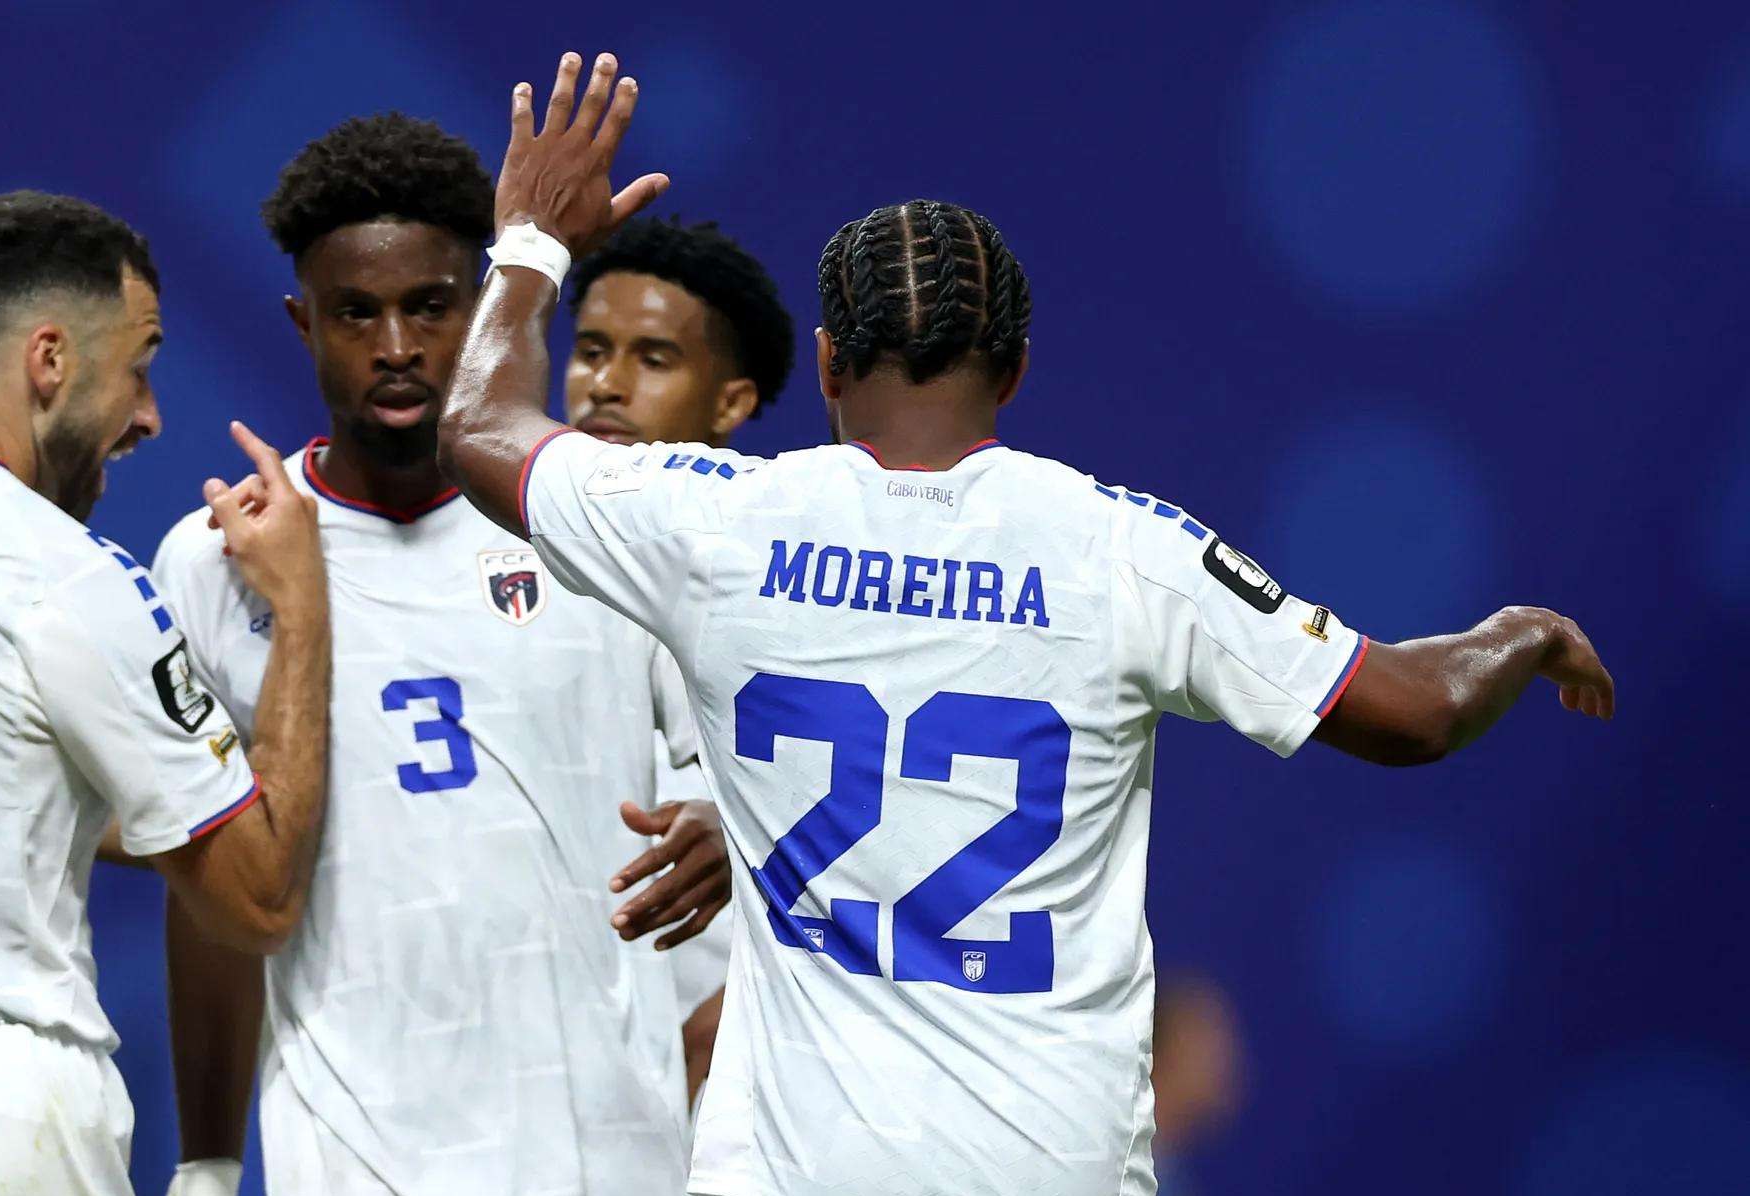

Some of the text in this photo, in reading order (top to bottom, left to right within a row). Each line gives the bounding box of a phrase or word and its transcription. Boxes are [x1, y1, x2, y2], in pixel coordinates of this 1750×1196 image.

[920, 486, 954, 507] VERDE
[759, 540, 1050, 628] MOREIRA
[381, 677, 477, 793] 3
[734, 672, 1072, 993] 22
